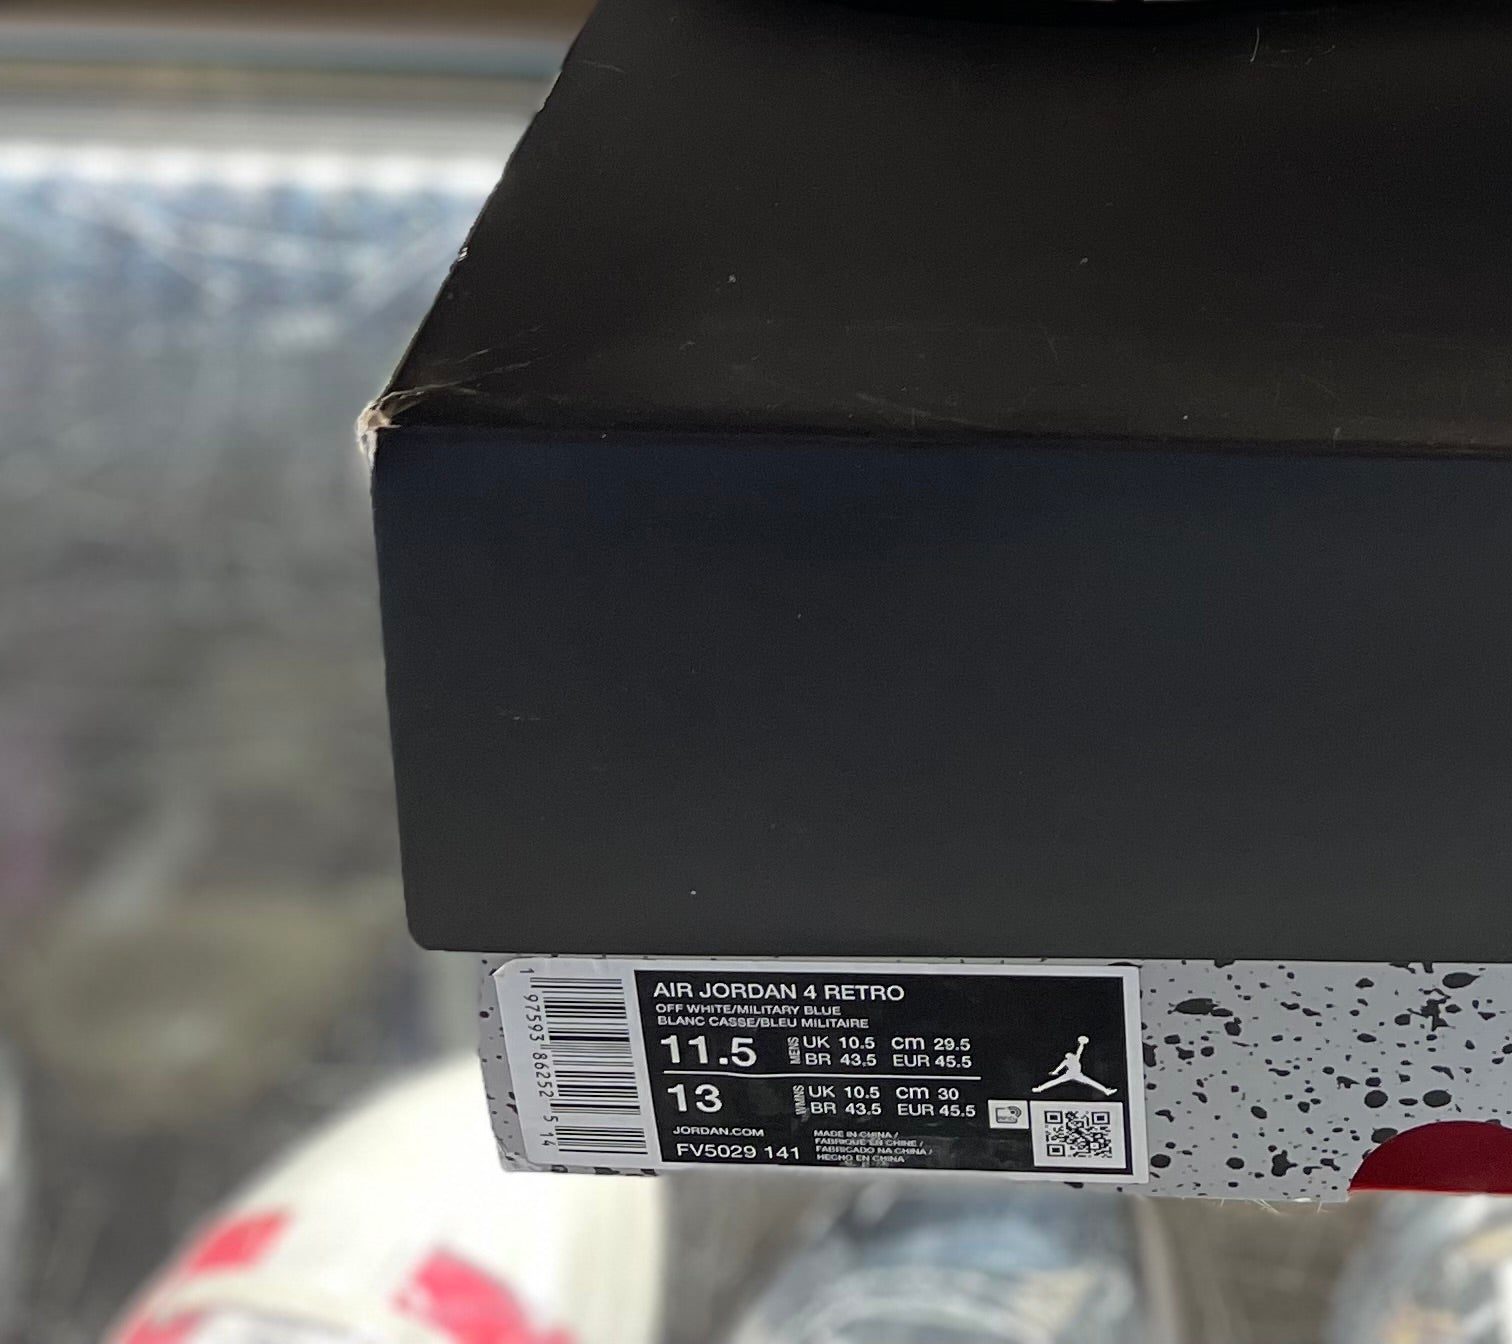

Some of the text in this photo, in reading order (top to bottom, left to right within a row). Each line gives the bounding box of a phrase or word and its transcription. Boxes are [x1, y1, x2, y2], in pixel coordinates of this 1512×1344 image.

[653, 982, 905, 1001] AIR JORDAN 4 RETRO
[655, 1003, 841, 1016] OFF WHITE/MILITARY BLUE
[523, 993, 545, 1042] 97593
[657, 1015, 869, 1029] BLANC CASSE/BLEU MILITAIRE
[660, 1034, 757, 1067] 11.5
[803, 1036, 971, 1051] UK 10.5 cm 29.5
[805, 1053, 972, 1068] BR 43.5 EUR 45.5
[532, 1052, 555, 1098] 86252
[666, 1083, 723, 1113] 13
[808, 1085, 959, 1101] UK 10.5 cm 30
[810, 1102, 976, 1117] BR 43.5 EUR 45.5
[672, 1126, 765, 1137] JORDAN.COM
[813, 1129, 844, 1138] MADE
[676, 1143, 799, 1160] FV5029 141
